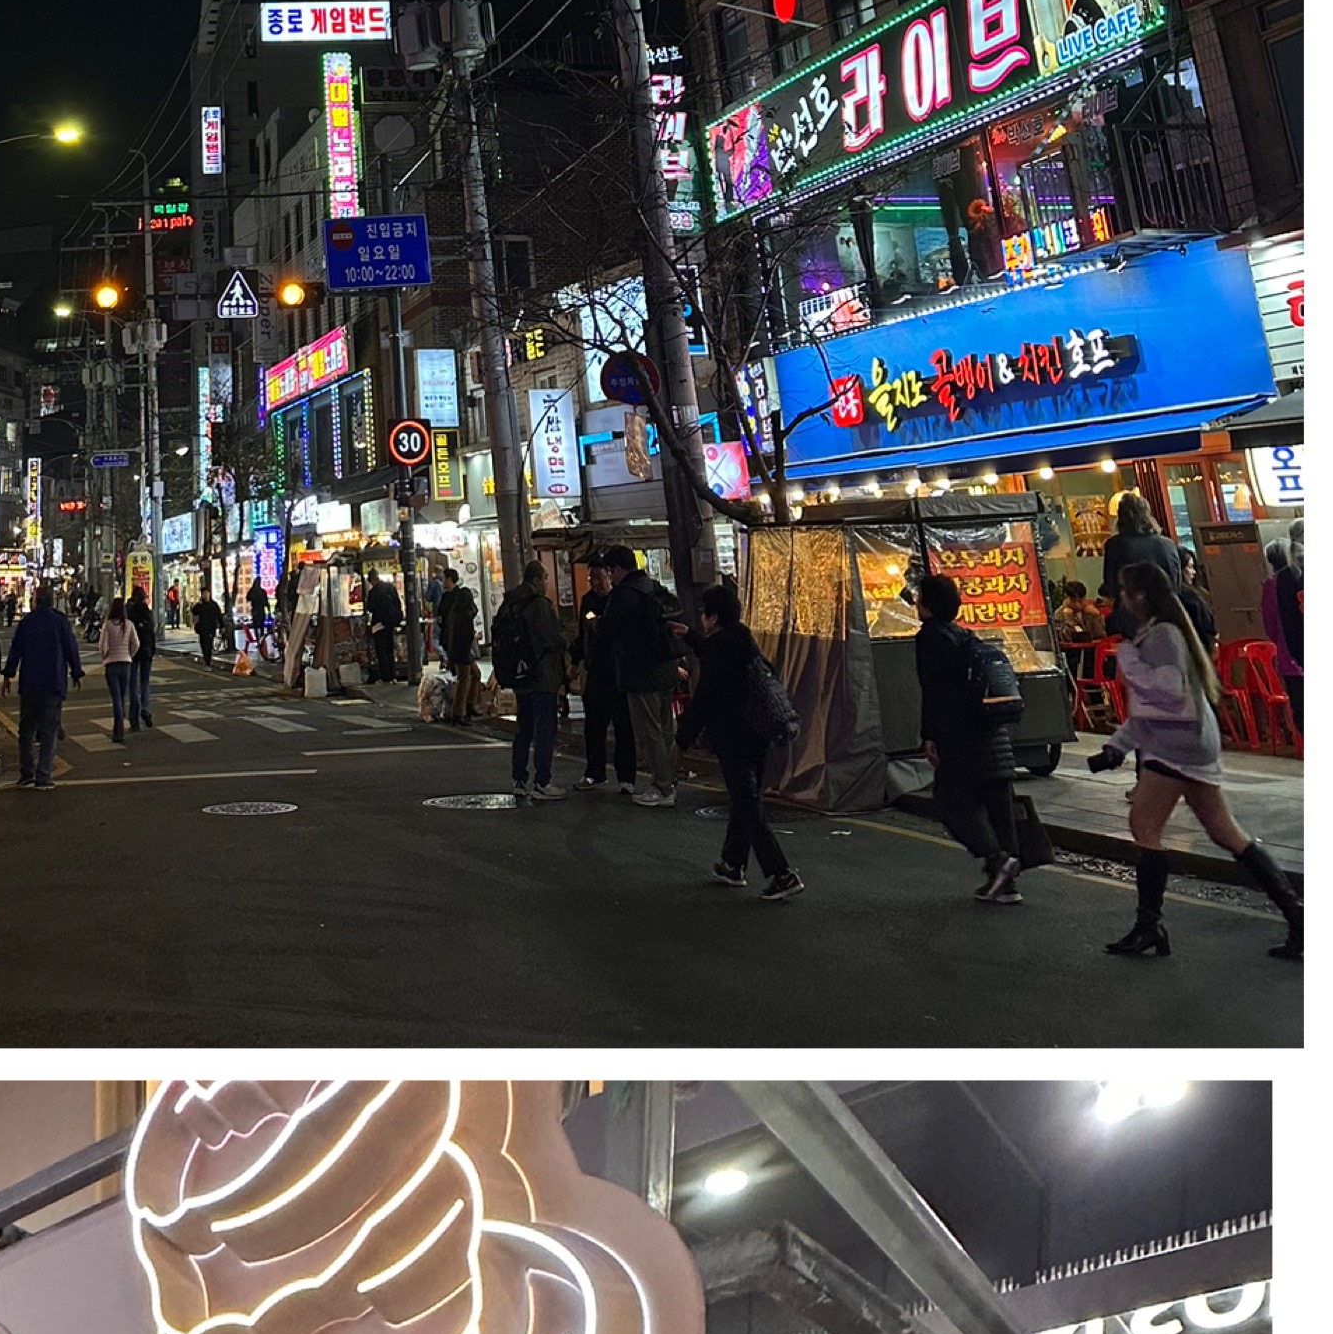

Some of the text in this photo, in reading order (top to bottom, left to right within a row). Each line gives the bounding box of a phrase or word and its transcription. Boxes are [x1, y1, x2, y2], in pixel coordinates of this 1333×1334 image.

[268, 7, 387, 36] 종로 게임랜드
[1058, 5, 1140, 63] LIVE CAFE
[772, 73, 838, 175] 박선호
[366, 221, 418, 239] 진입금지
[358, 245, 400, 261] 일요일
[345, 265, 416, 282] 10:00~22:00
[868, 357, 928, 431] 을지로
[929, 348, 995, 421] 골뱅이
[998, 355, 1012, 385] &
[1018, 337, 1064, 386] 치킨
[1065, 329, 1116, 379] 호프
[398, 432, 421, 452] 30
